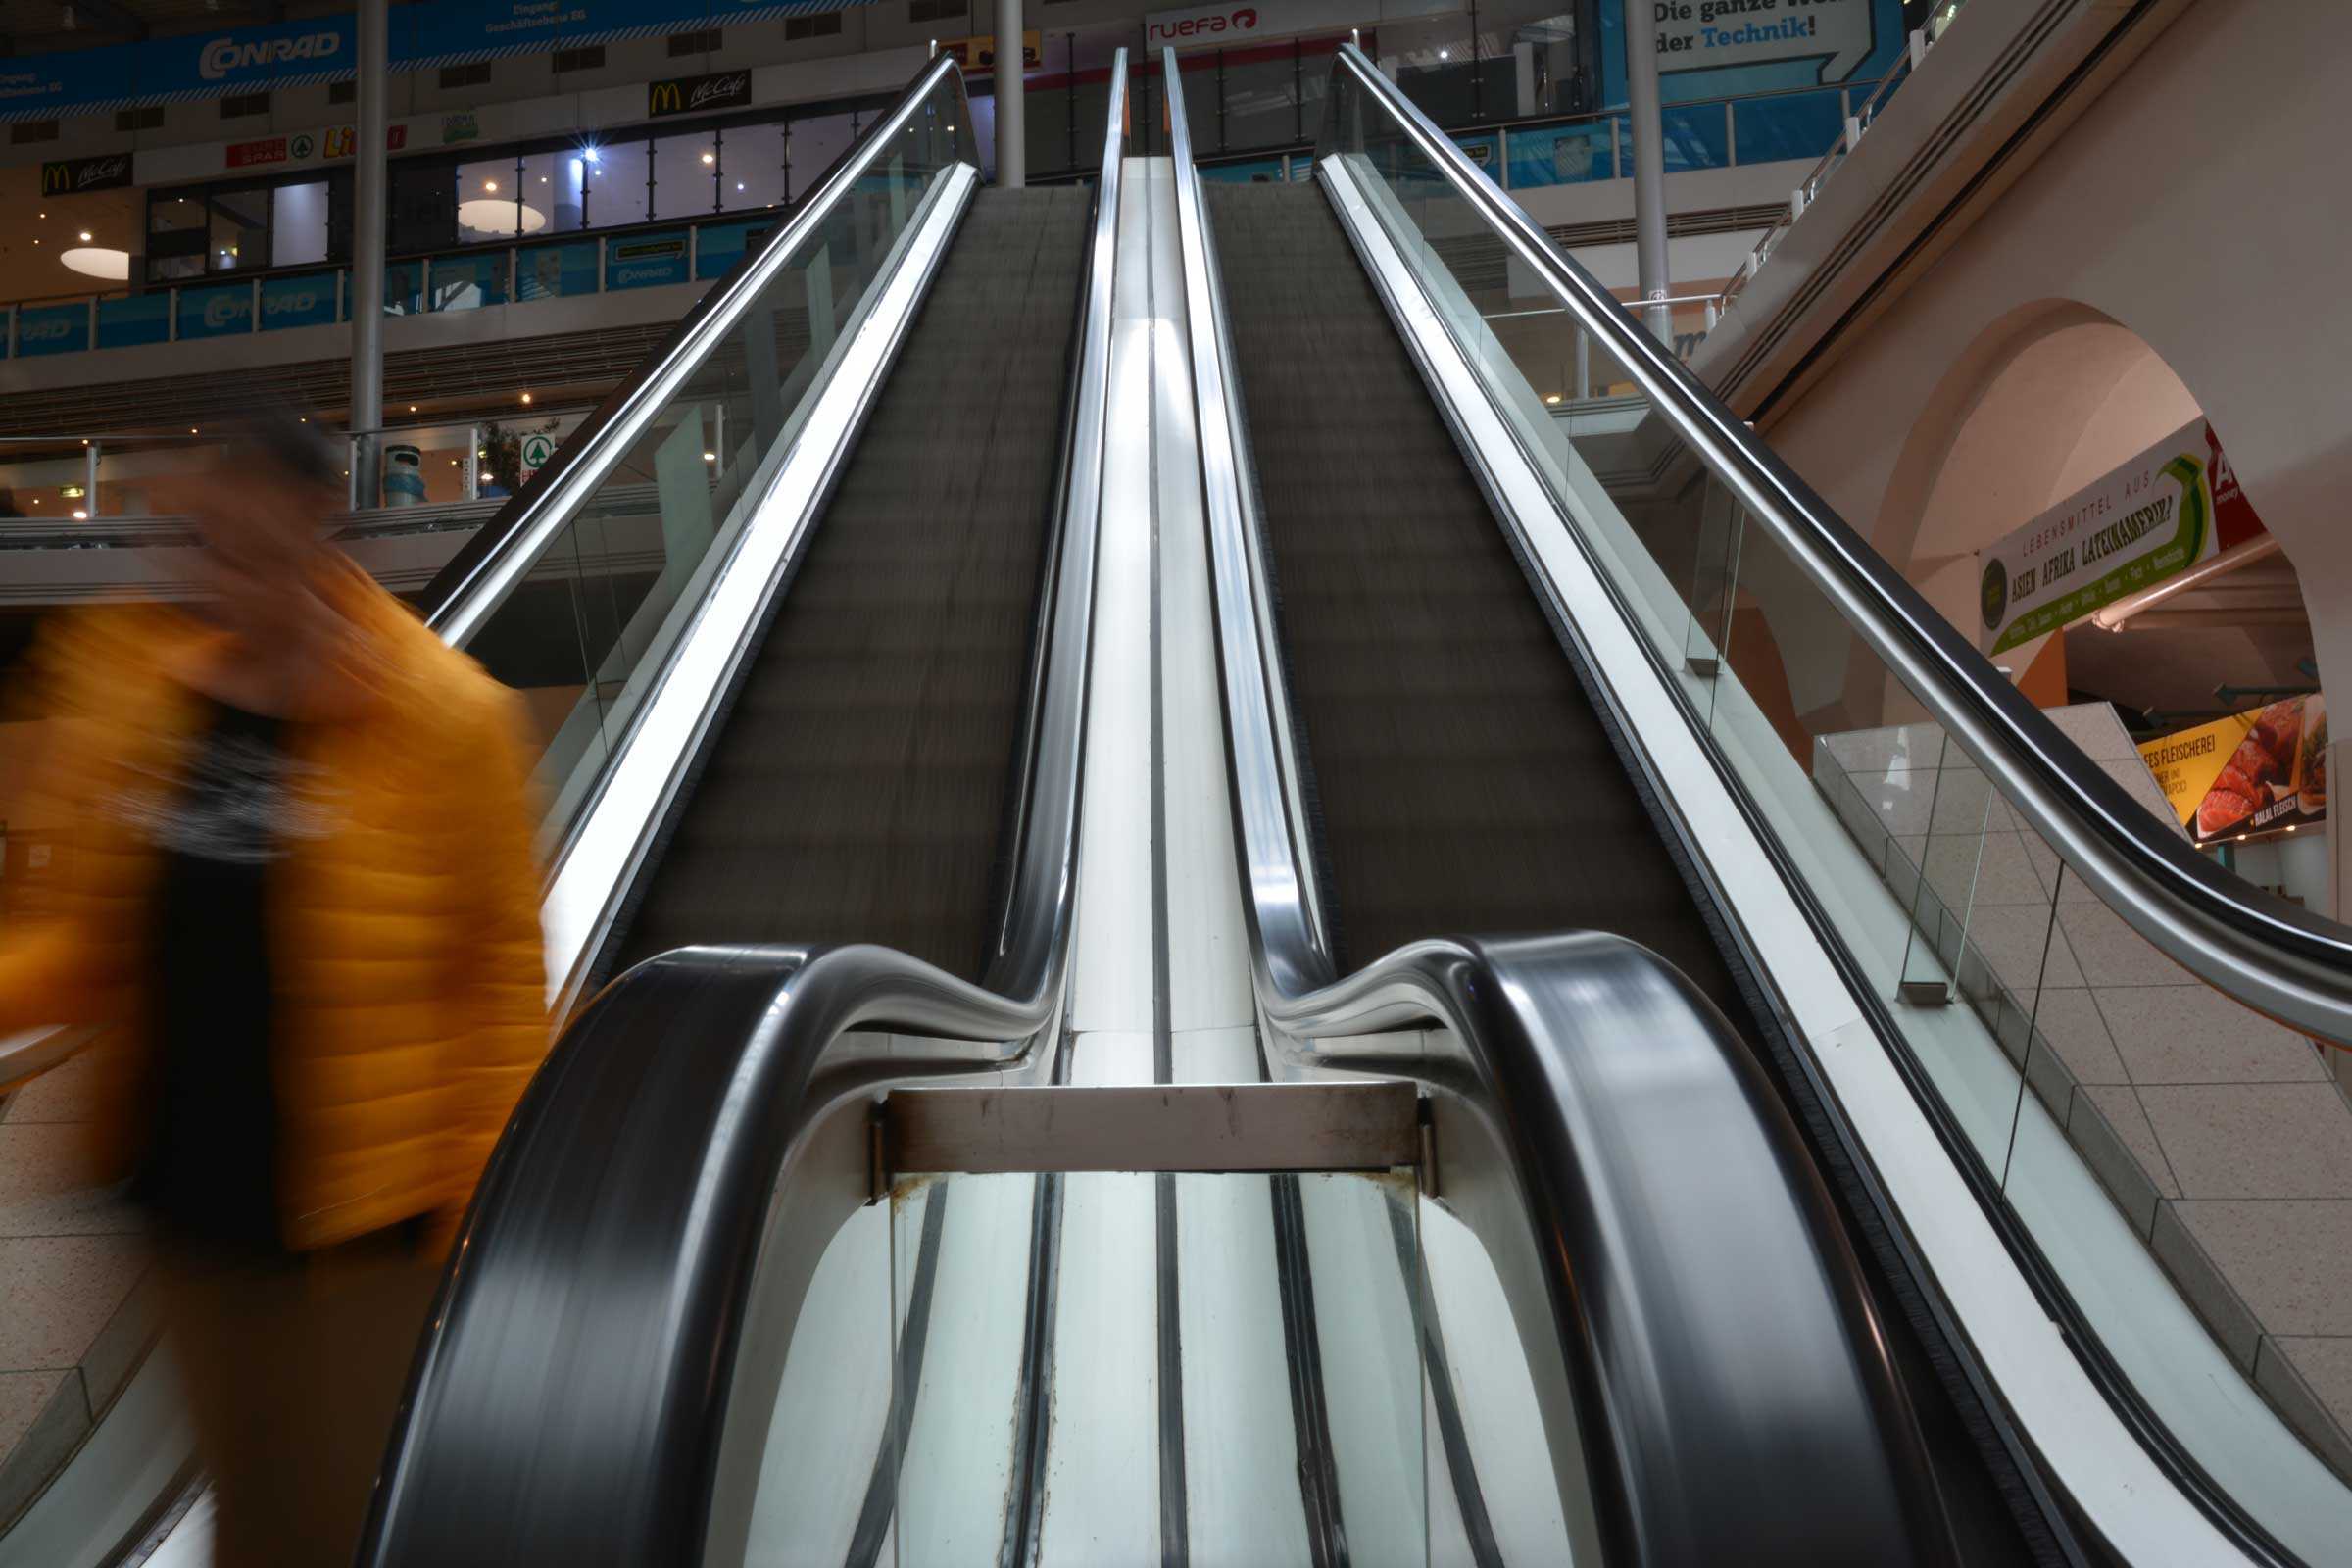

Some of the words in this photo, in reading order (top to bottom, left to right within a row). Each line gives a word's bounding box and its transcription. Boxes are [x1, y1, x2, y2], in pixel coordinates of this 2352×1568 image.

[1149, 15, 1227, 41] ruefa
[1654, 2, 1692, 22] Die
[1700, 0, 1776, 23] ganze
[1655, 32, 1694, 54] der
[1700, 15, 1815, 48] Technik!
[199, 31, 340, 79] CONRAD
[243, 149, 284, 165] SPAR
[2022, 495, 2112, 558] LEBENSMITTEL
[2123, 470, 2150, 501] AUS
[2011, 566, 2036, 603] ASIEN
[2042, 547, 2076, 588] AFRIKA
[2160, 734, 2216, 766] FLEISCHEREI
[2254, 807, 2274, 828] HALAL
[2273, 795, 2297, 818] FLEISCH
